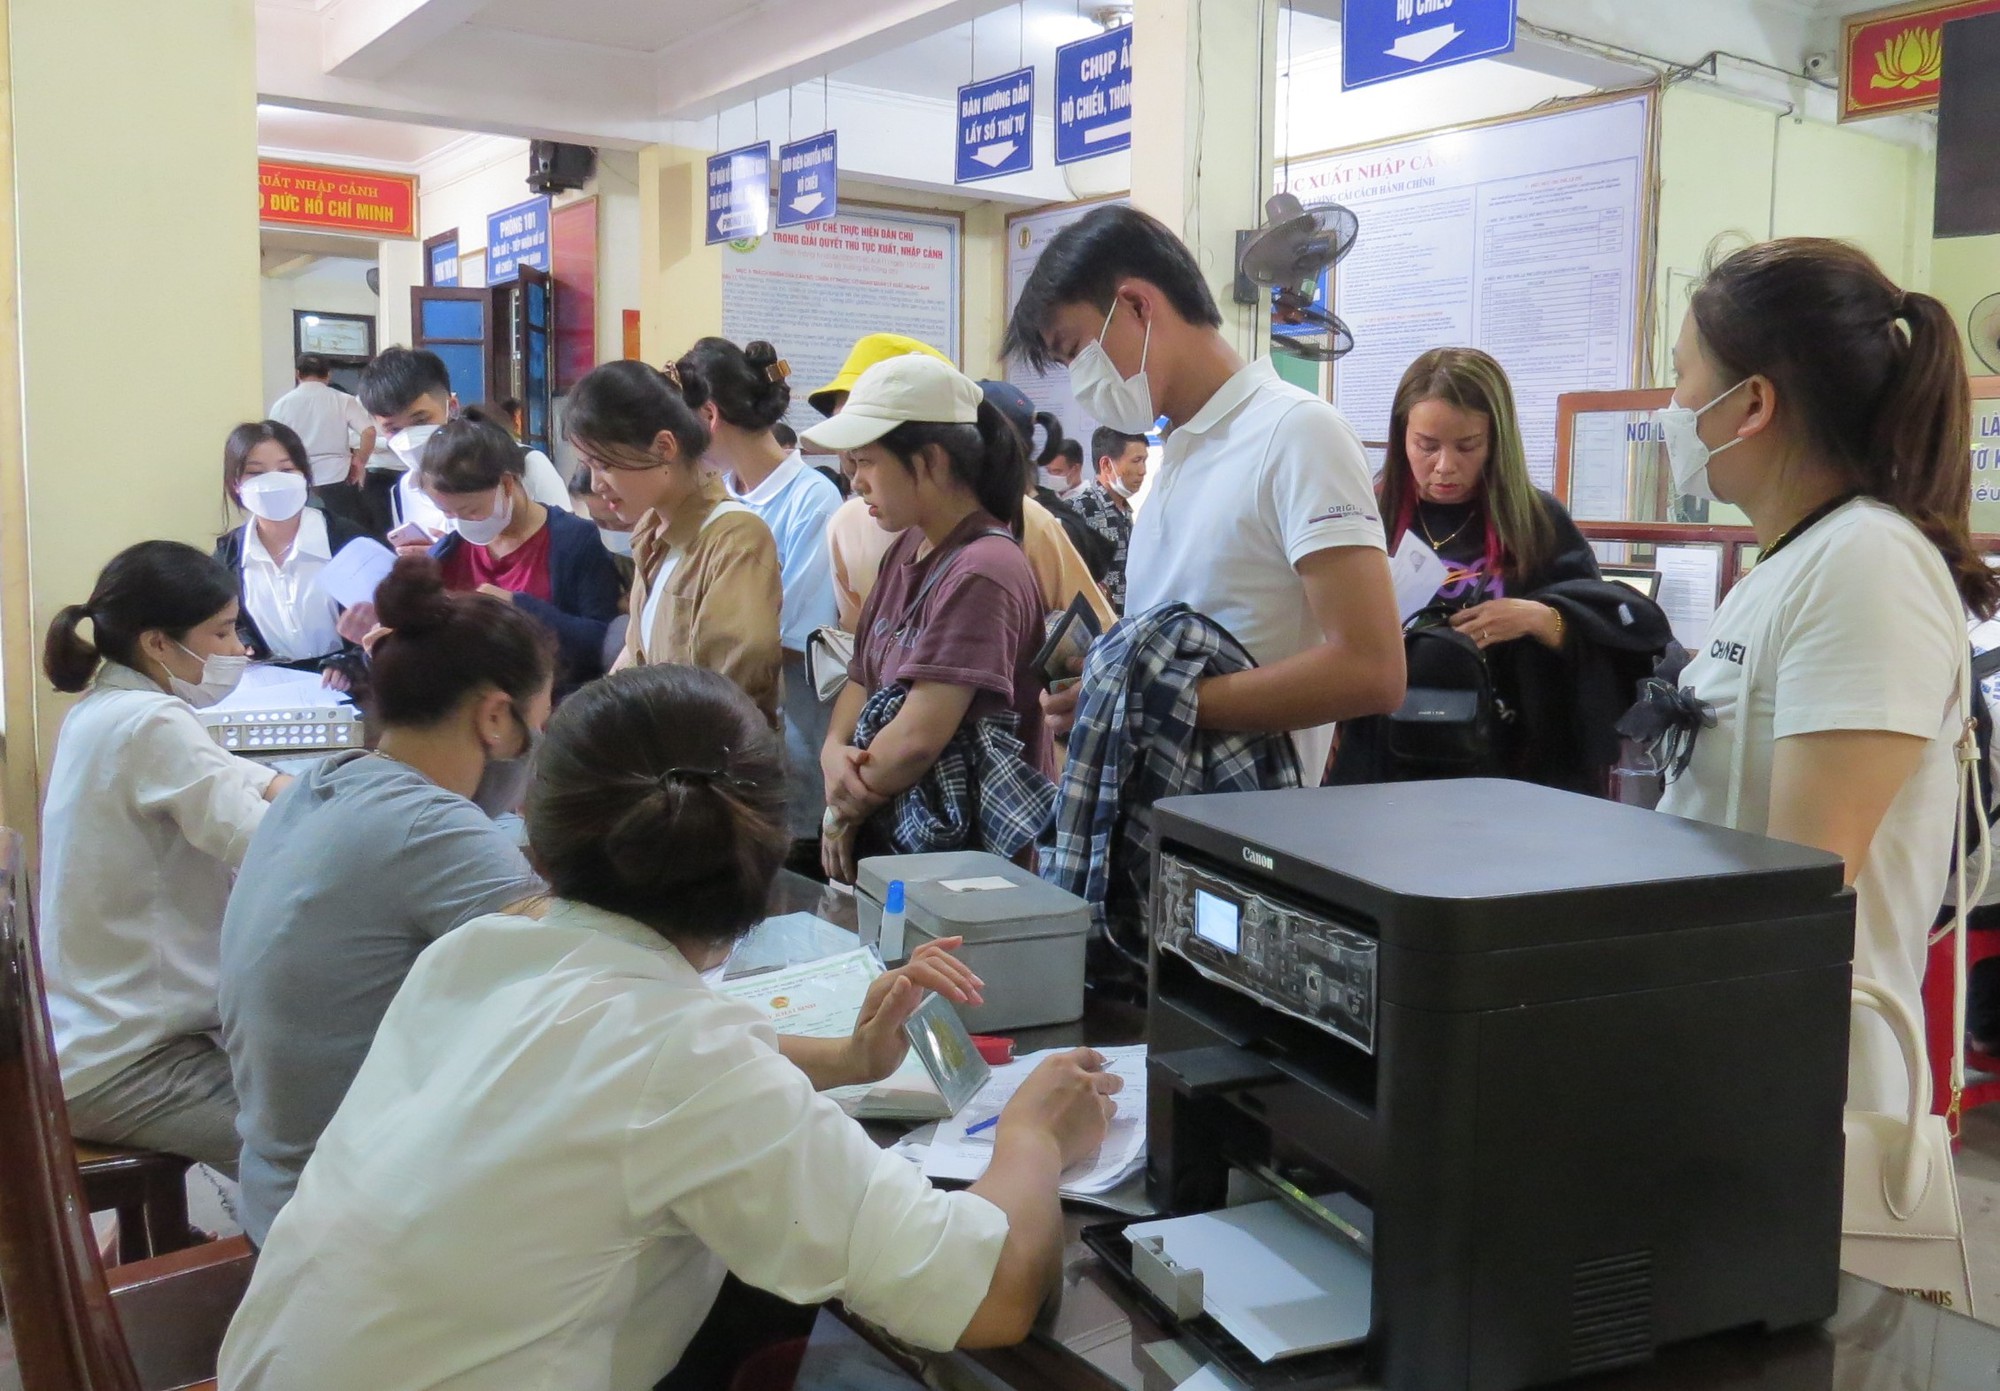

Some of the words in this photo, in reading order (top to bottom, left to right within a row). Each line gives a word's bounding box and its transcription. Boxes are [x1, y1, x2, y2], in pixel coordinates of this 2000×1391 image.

[1081, 50, 1116, 82] CHỤP
[962, 96, 981, 118] BÀN
[982, 90, 1010, 113] HƯỚNG
[1012, 79, 1030, 105] DẪN
[1061, 95, 1074, 128] HỘ
[1077, 85, 1107, 120] CHIẾU,
[965, 120, 982, 144] LẤY
[984, 116, 996, 141] SỐ
[997, 114, 1013, 138] THỨ
[1015, 112, 1026, 136] TỰ
[295, 179, 336, 193] NHẬP
[339, 182, 378, 198] CẢNH
[1274, 177, 1304, 195] TC
[1309, 163, 1353, 189] XUẤT
[1358, 156, 1406, 180] NHẬP
[1338, 190, 1353, 203] CẢI
[1354, 187, 1378, 199] CÁCH
[1380, 181, 1405, 196] HÀNH
[1406, 176, 1436, 191] CHÍNH
[270, 191, 300, 212] ĐỨC
[305, 191, 324, 215] HỒ
[328, 198, 352, 219] CHÍ
[356, 203, 394, 223] MINH
[500, 214, 523, 239] PHÒNG
[523, 211, 536, 231] 101
[823, 221, 839, 233] CHẾ
[840, 223, 860, 237] THỰC
[861, 224, 879, 239] HIỆN
[881, 226, 897, 240] DÂN
[898, 227, 914, 242] CHỦ
[772, 232, 799, 244] TRONG
[801, 231, 817, 246] GIẢI
[819, 234, 844, 248] QUYẾT
[845, 237, 860, 251] THỦ
[861, 241, 876, 253] TỤC
[900, 243, 921, 258] NHẬP
[922, 245, 943, 259] CẢNH
[1627, 421, 1650, 441] NƠI
[1242, 846, 1273, 870] Canon
